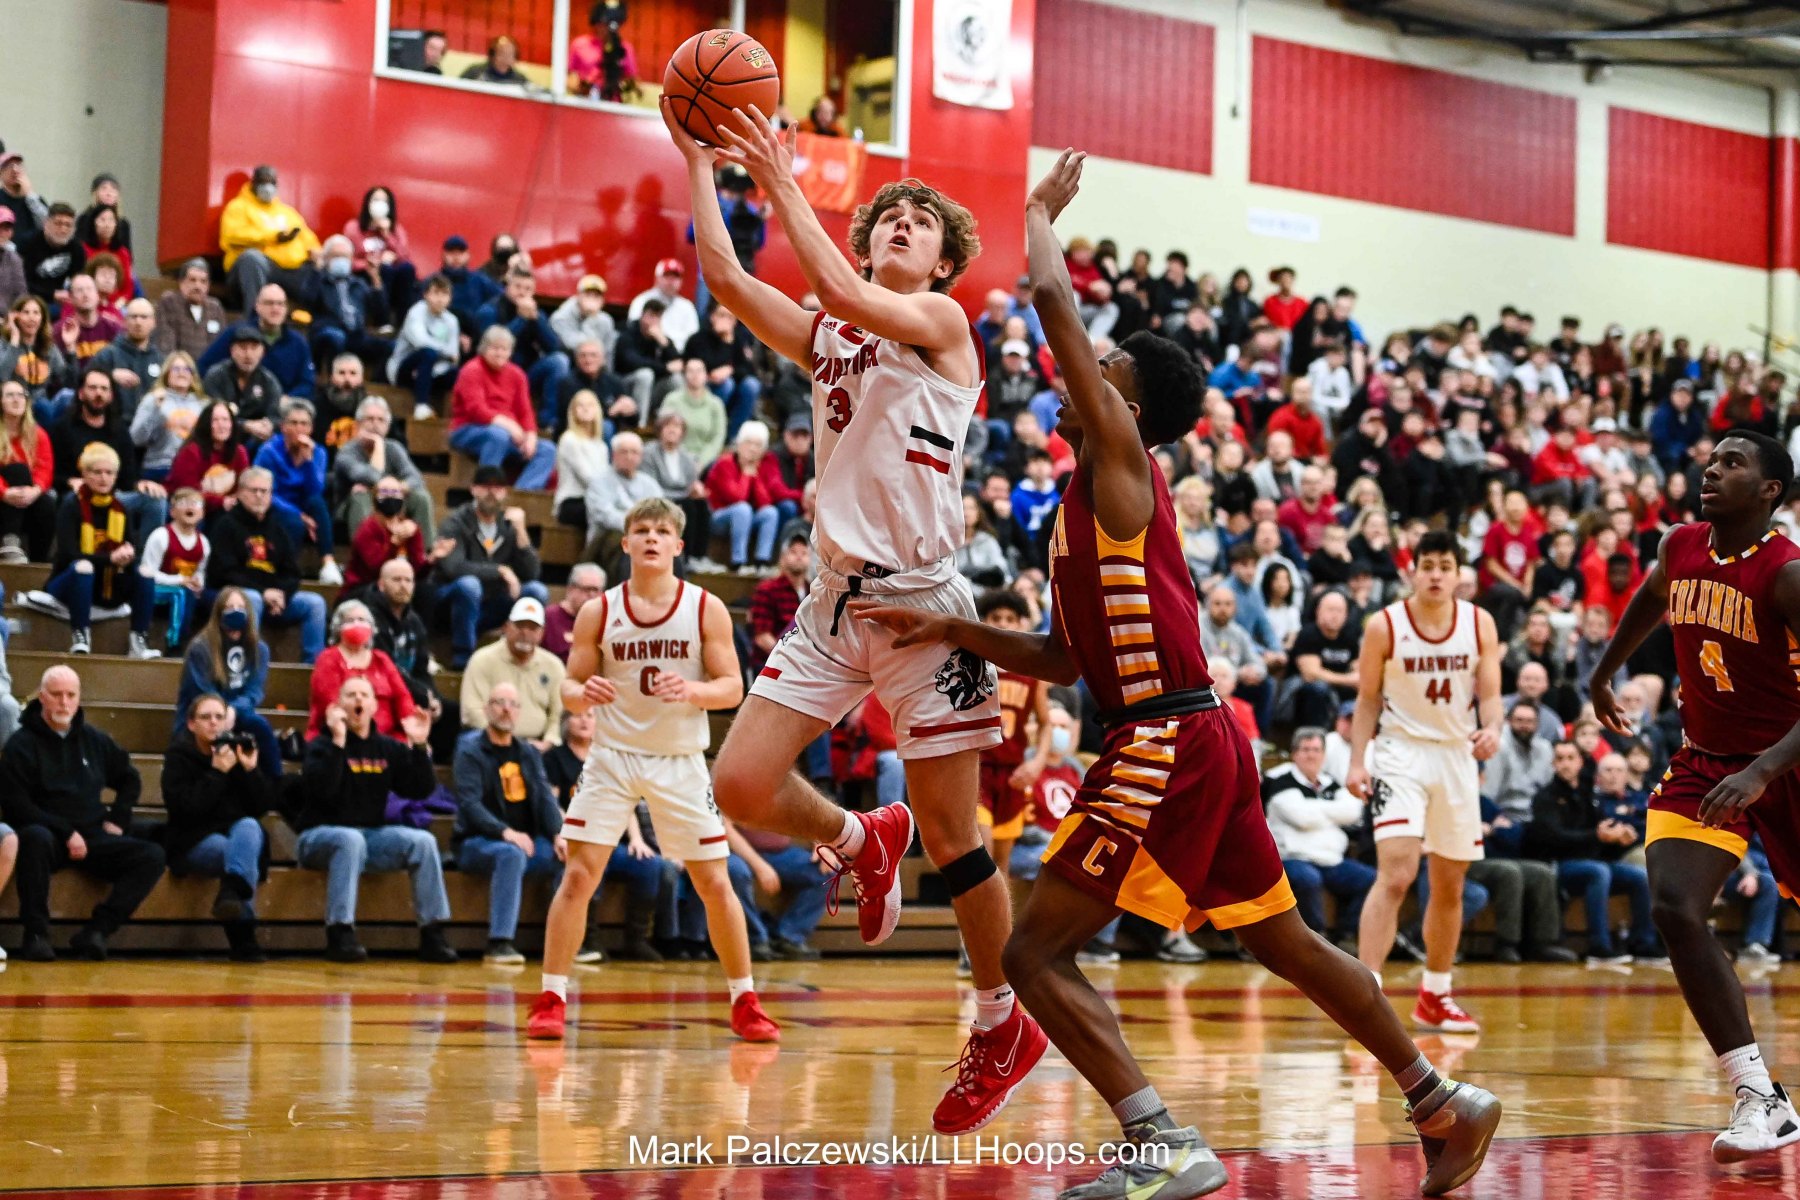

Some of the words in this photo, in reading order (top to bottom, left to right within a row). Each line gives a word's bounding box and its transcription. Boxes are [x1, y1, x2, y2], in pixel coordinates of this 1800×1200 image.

[826, 387, 852, 433] 3
[1669, 579, 1759, 644] COLUMBIA
[612, 639, 689, 661] WARWICK
[1403, 654, 1469, 674] WARWICK
[1699, 640, 1735, 692] 4
[1425, 678, 1452, 705] 44
[1082, 835, 1118, 876] C
